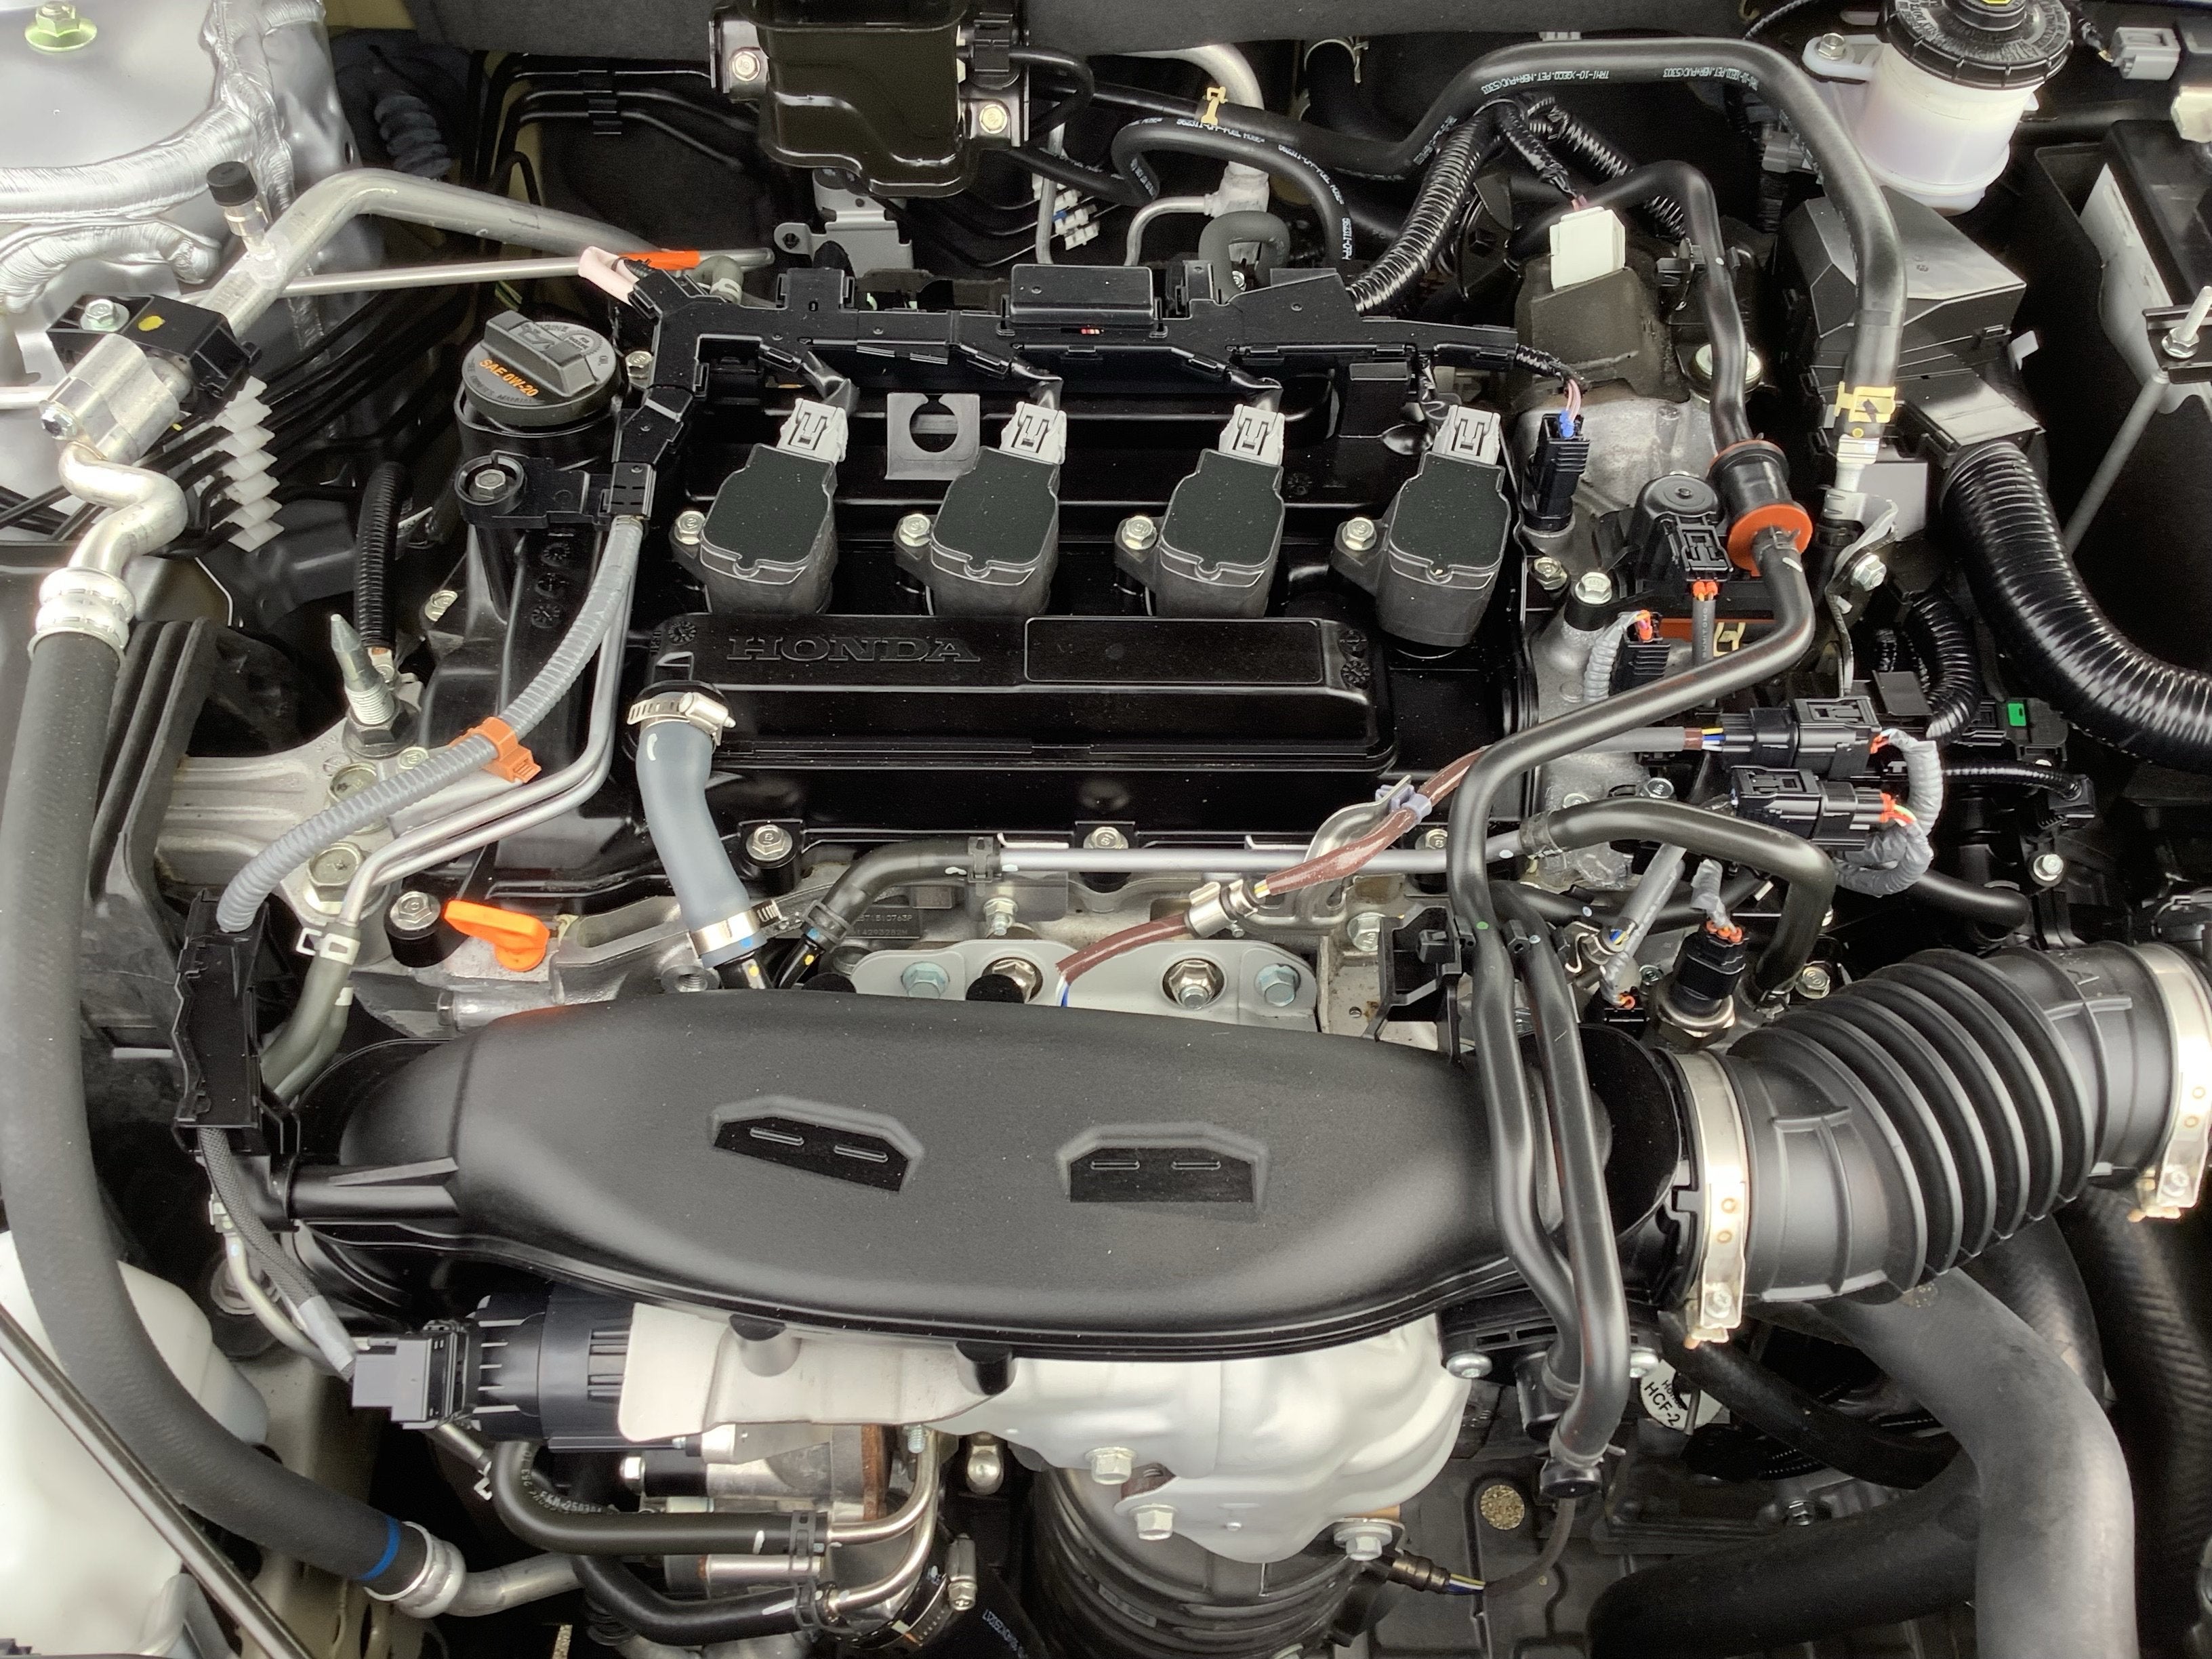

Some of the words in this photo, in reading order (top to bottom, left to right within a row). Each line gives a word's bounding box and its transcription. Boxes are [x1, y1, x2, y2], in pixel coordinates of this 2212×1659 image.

[479, 359, 508, 377] SAE
[503, 373, 539, 397] 0W-20
[726, 637, 981, 662] HONDA
[1644, 1381, 1681, 1427] HCF-2
